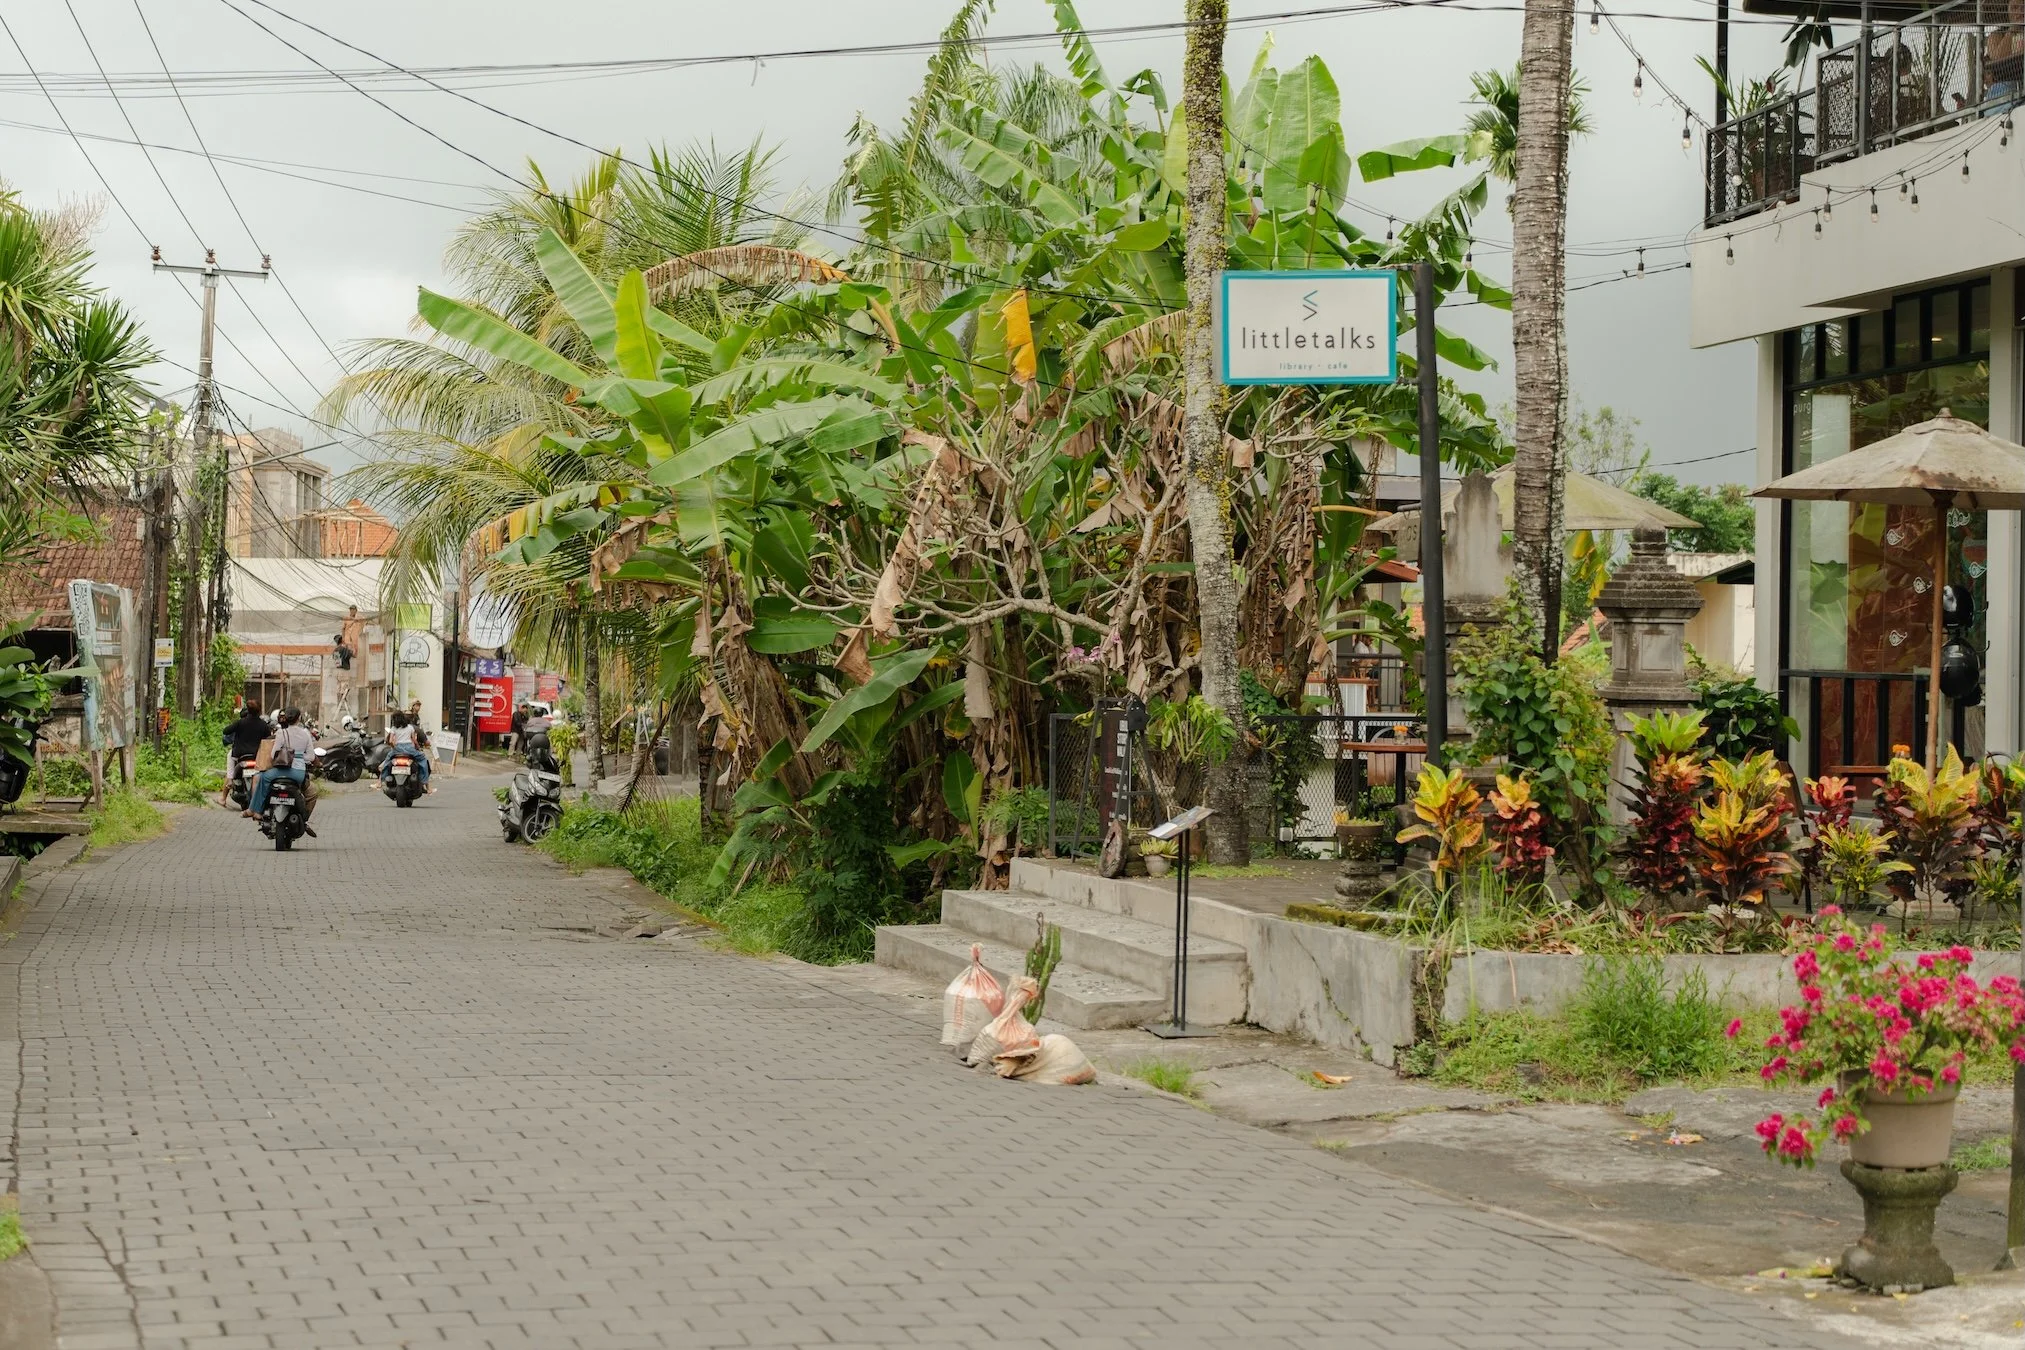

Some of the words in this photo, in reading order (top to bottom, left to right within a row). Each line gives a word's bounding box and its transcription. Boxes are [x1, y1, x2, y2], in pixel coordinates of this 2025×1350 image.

[1242, 327, 1375, 349] littletalks
[1279, 362, 1312, 371] library
[1327, 361, 1348, 370] cafe
